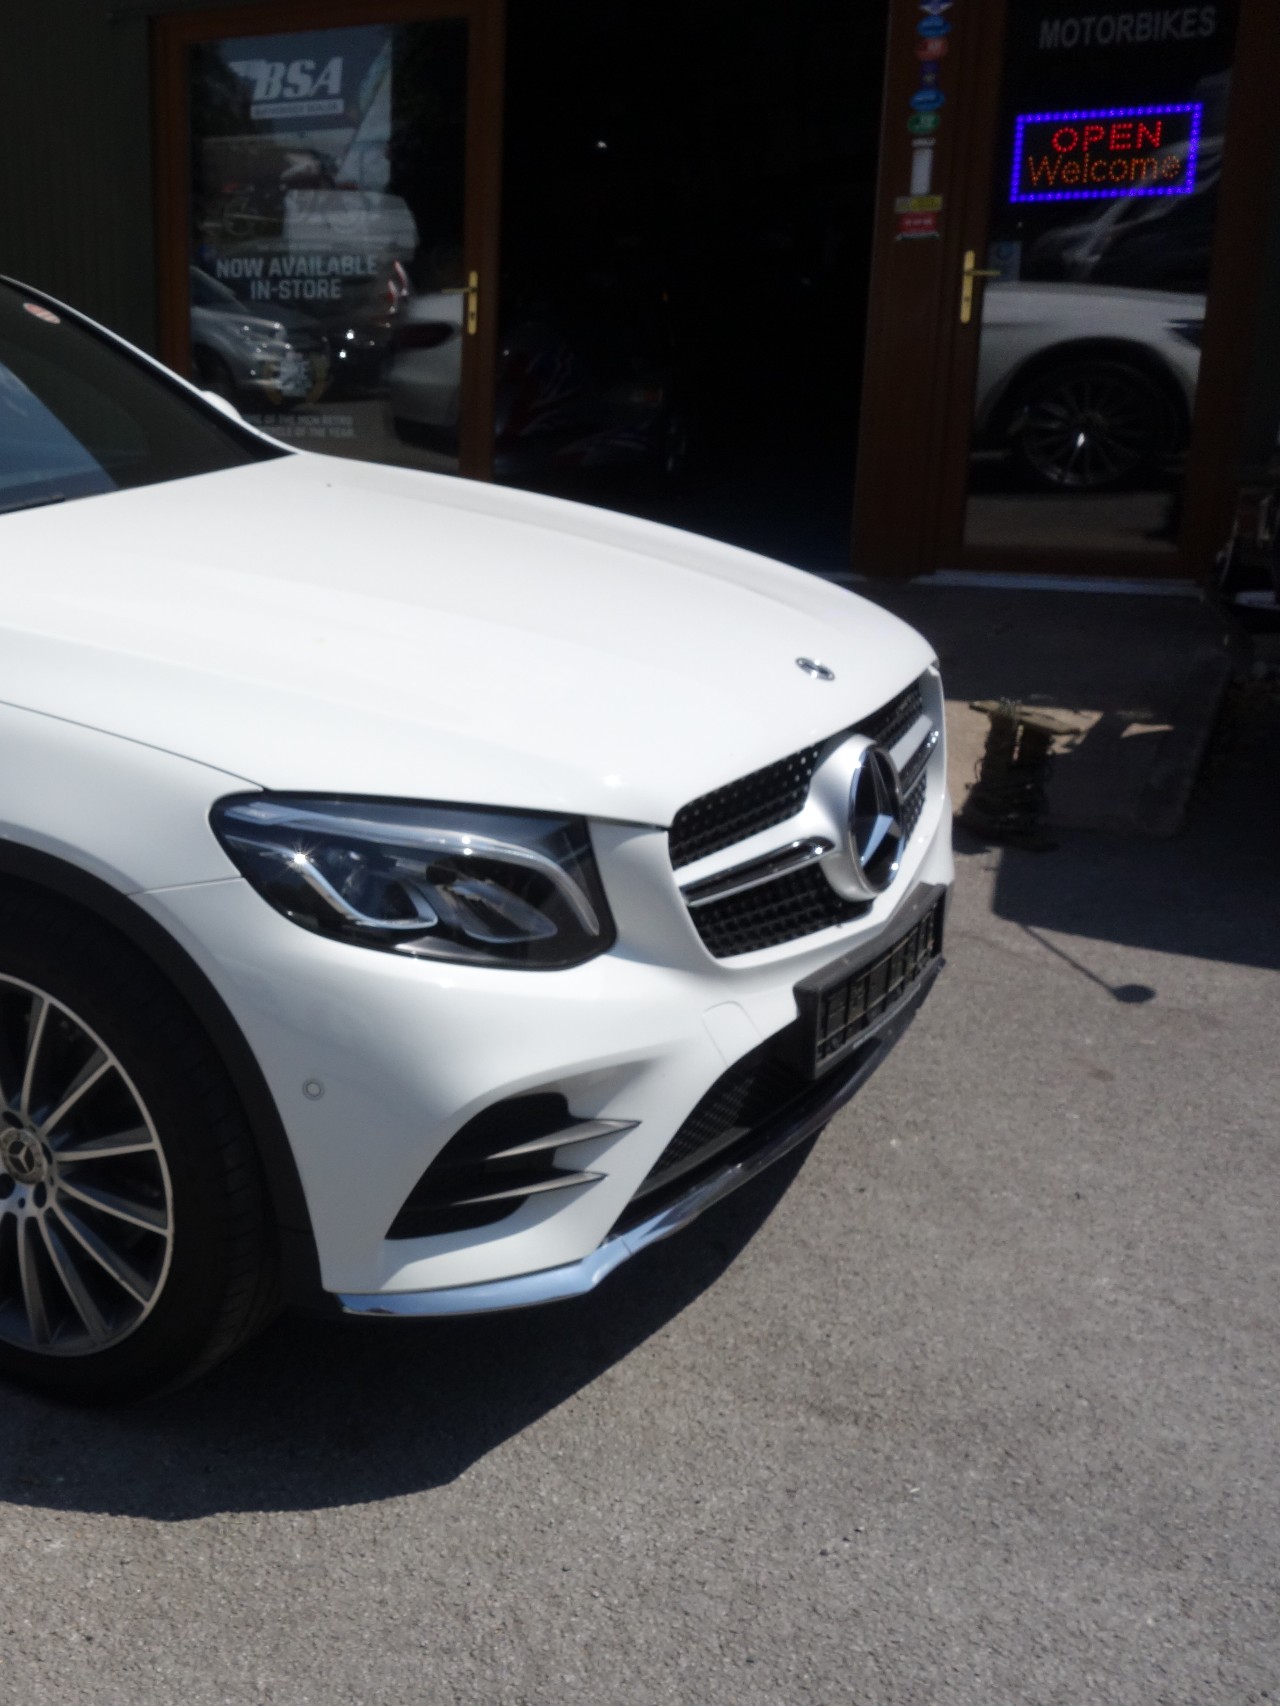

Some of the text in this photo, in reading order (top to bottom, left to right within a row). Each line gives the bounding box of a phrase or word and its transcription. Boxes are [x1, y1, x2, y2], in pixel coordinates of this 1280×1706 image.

[1039, 5, 1217, 49] MOTORBIKES
[228, 56, 344, 101] BSA
[1051, 120, 1162, 153] OPEN
[1027, 152, 1181, 187] Welcome
[216, 254, 378, 279] NOW AVAILABLE
[250, 278, 343, 301] IN-STORE
